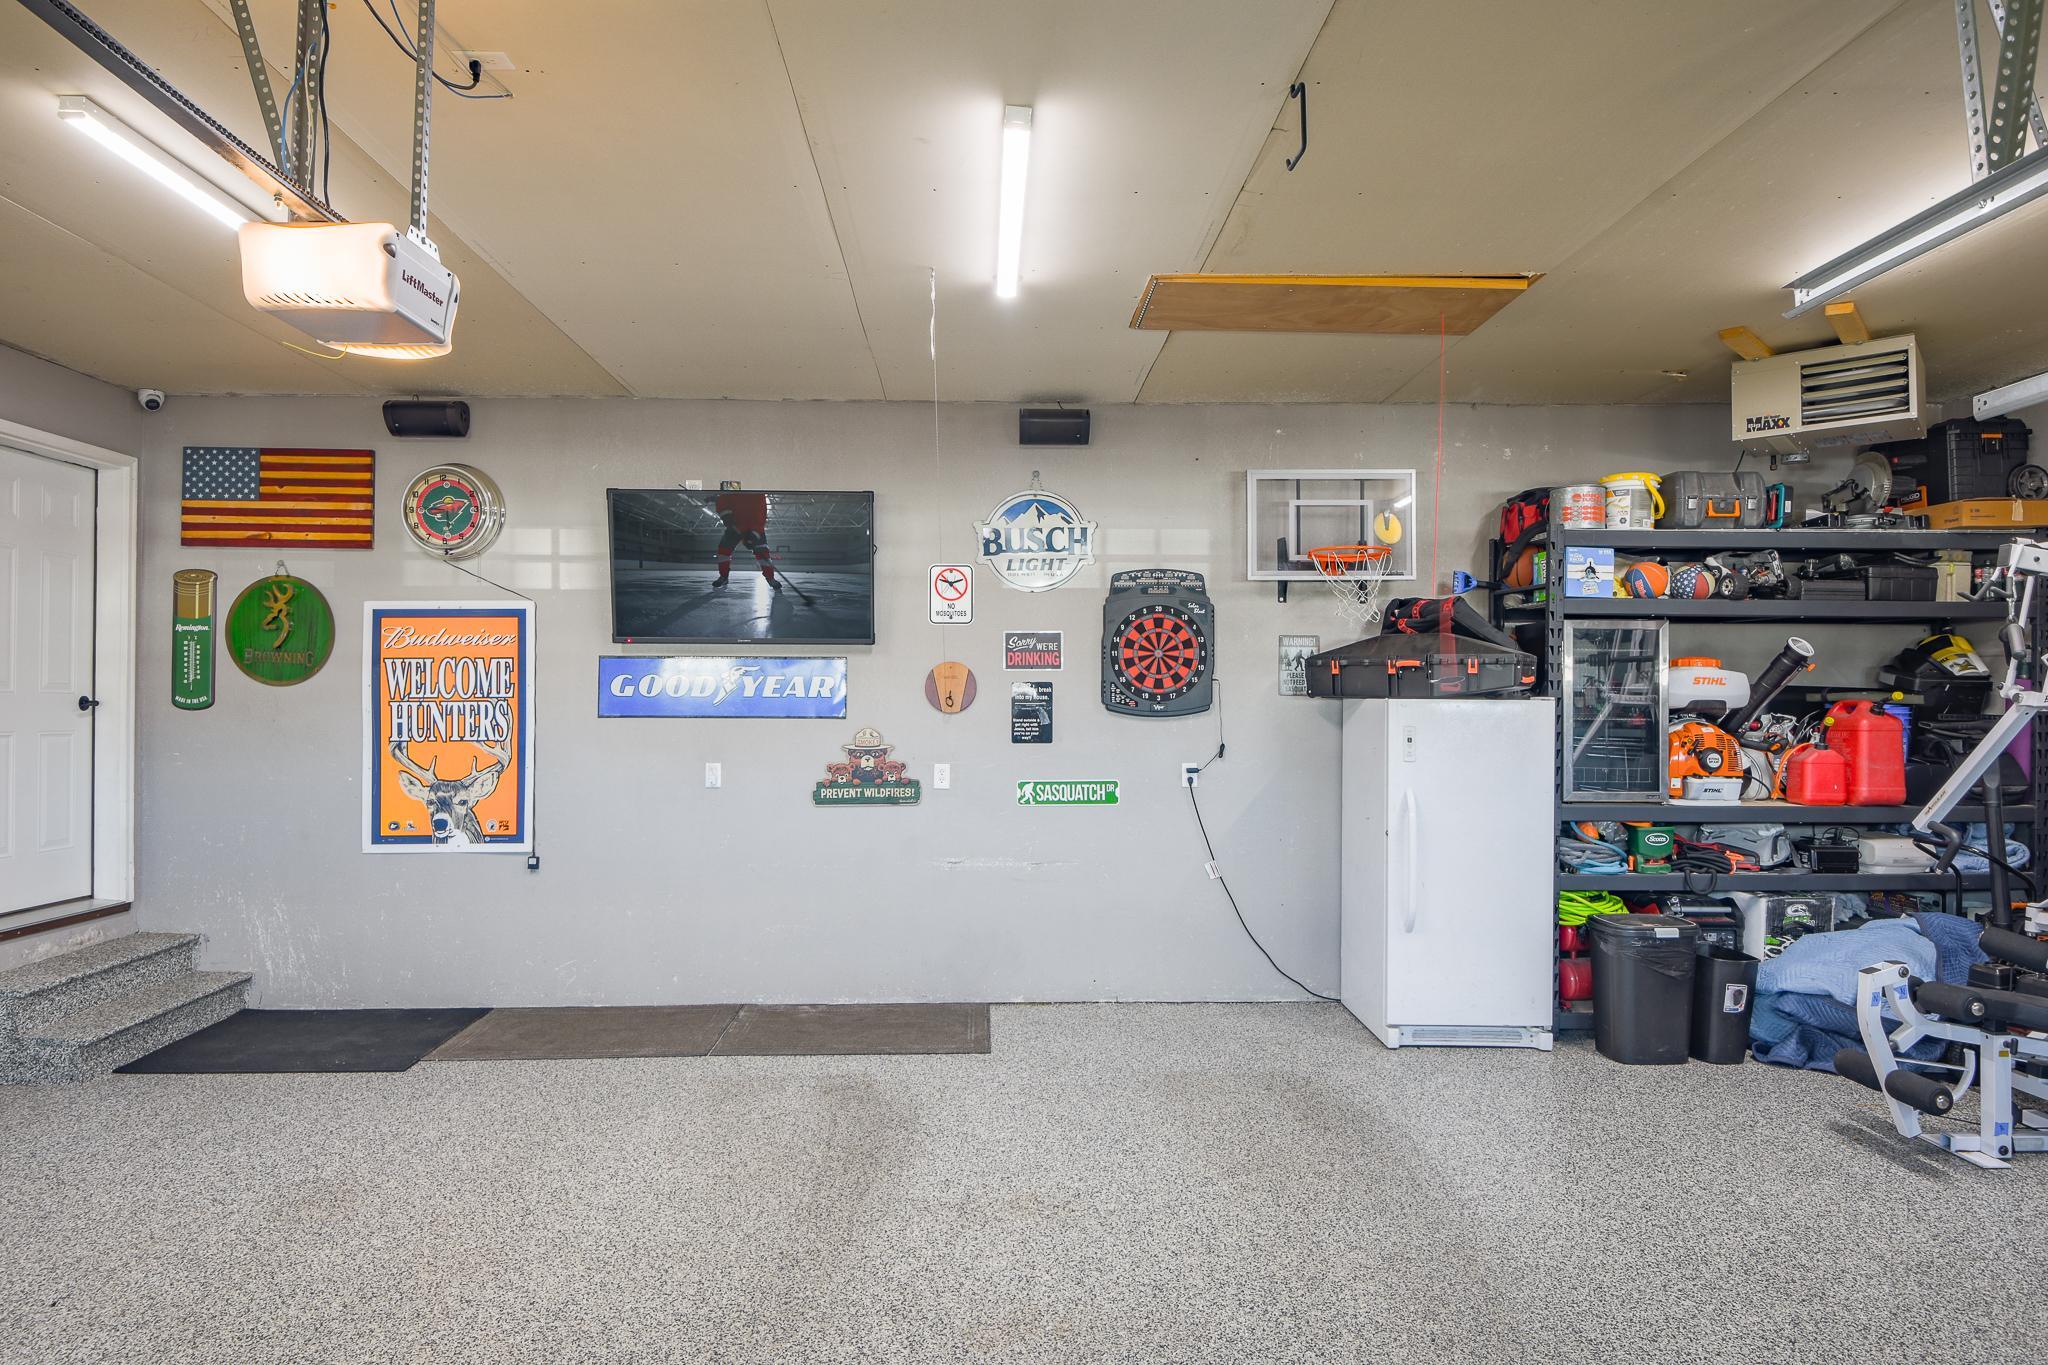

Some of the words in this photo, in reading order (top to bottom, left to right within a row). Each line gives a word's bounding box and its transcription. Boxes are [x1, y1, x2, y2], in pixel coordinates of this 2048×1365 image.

[402, 269, 443, 306] LiftMaster
[982, 526, 1088, 556] BUSCH
[1006, 558, 1068, 571] LIGHT
[175, 623, 209, 633] Remington
[383, 625, 517, 649] Budweiser
[1007, 636, 1037, 650] Sorry
[1036, 642, 1059, 651] WE'RE
[1282, 636, 1316, 646] WARNING!
[243, 648, 314, 667] BROWNING
[1007, 651, 1060, 666] DRINKING
[383, 656, 516, 700] WELCOME
[1692, 676, 1727, 686] STIHL
[175, 695, 186, 704] MADE
[199, 695, 208, 703] USA
[388, 700, 509, 743] HUNTERS
[820, 788, 862, 799] PREVENT
[864, 787, 916, 798] WILDFIRES!
[1035, 784, 1105, 802] SASQUATCH
[1106, 783, 1115, 793] DR
